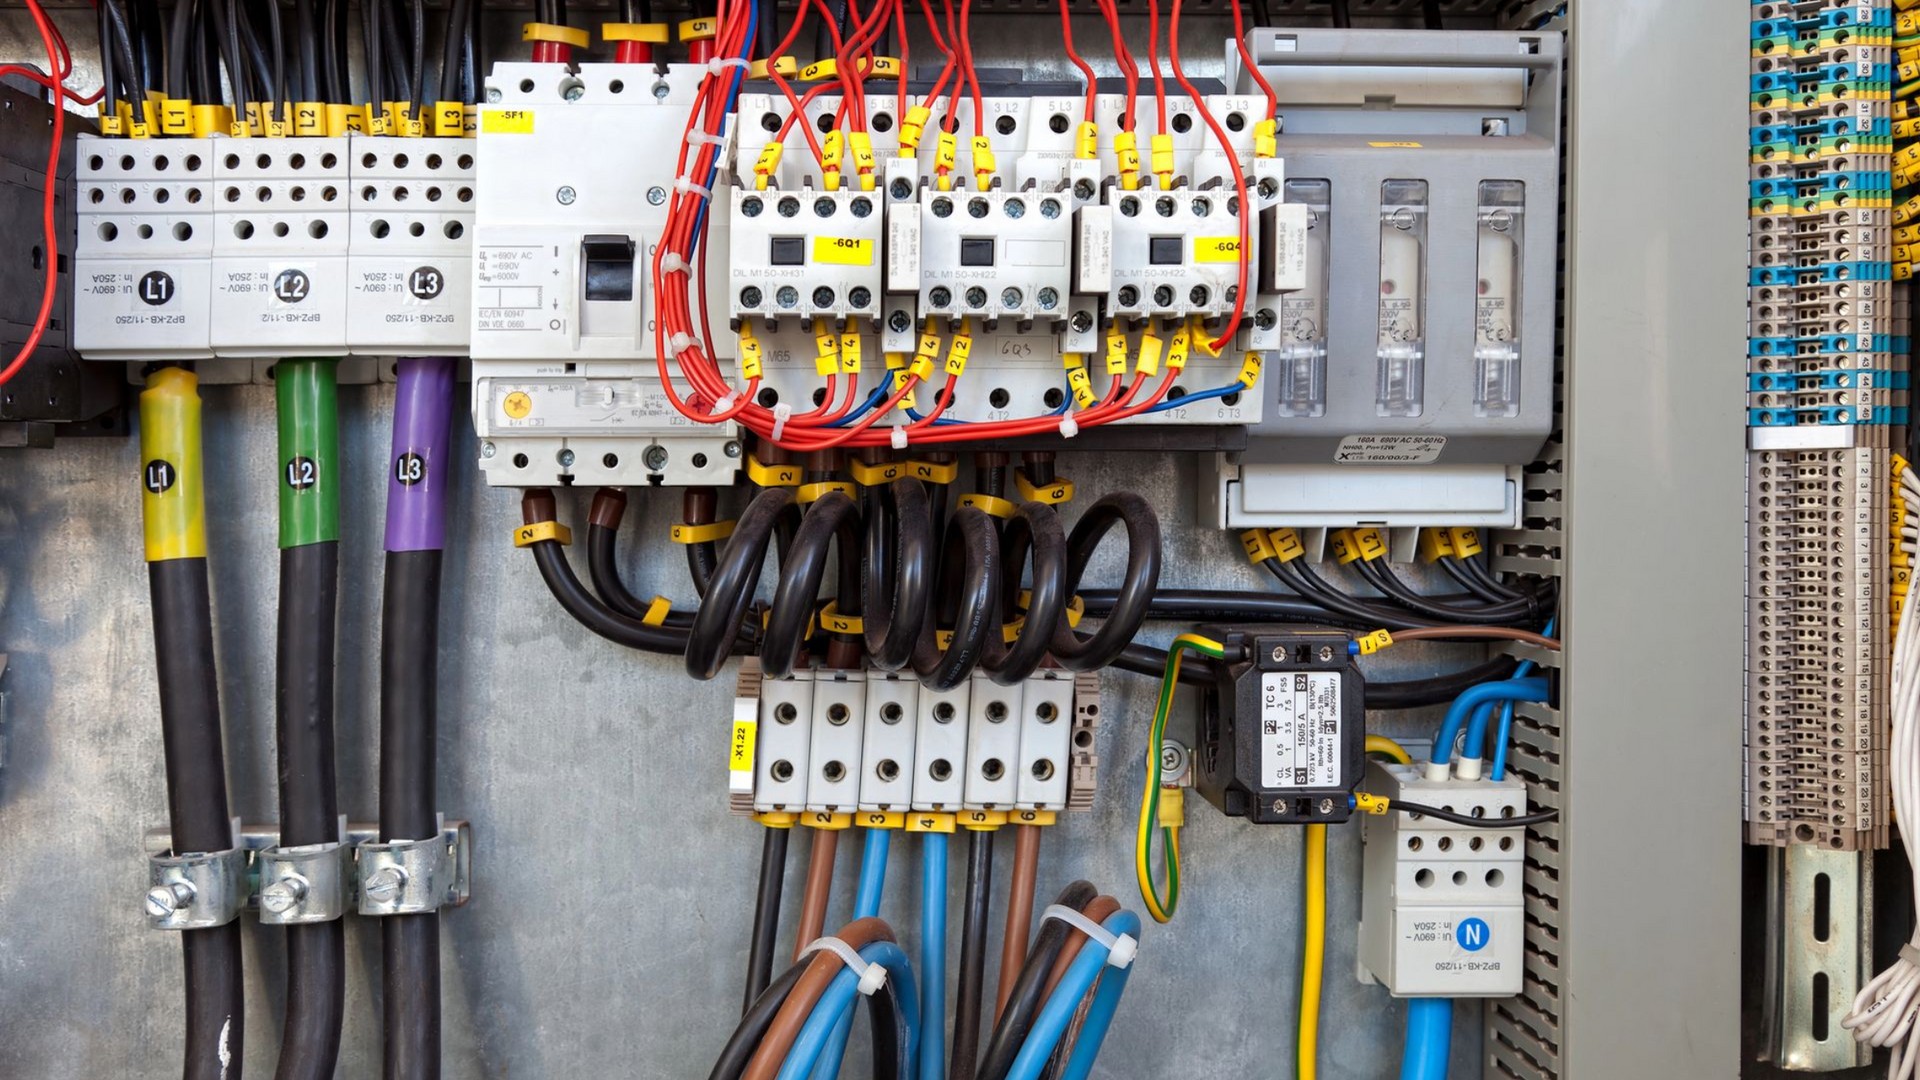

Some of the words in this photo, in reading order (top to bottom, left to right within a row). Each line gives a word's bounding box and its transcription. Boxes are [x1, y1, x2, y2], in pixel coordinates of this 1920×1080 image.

[1860, 9, 1868, 21] 28
[1860, 48, 1868, 59] 29
[875, 60, 890, 69] 5
[1860, 63, 1868, 74] 30
[805, 66, 818, 77] 3
[1903, 65, 1912, 76] 3
[816, 101, 822, 109] 3
[882, 99, 894, 109] L3
[995, 103, 1001, 112] 3
[1006, 103, 1018, 113] L2
[1049, 102, 1055, 111] 5
[1060, 102, 1072, 111] L3
[1171, 101, 1177, 111] 3
[1183, 101, 1194, 111] L2
[1226, 101, 1232, 110] 5
[1237, 101, 1249, 110] L3
[1860, 103, 1869, 113] 31
[168, 109, 186, 127] L1
[299, 109, 316, 128] L2
[443, 109, 460, 128] L3
[501, 111, 525, 119] -5F1
[108, 115, 119, 130] L1
[232, 122, 242, 132] L2
[346, 113, 361, 131] L2
[373, 118, 384, 133] L3
[1860, 119, 1869, 129] 32
[134, 124, 146, 137] L1
[271, 123, 283, 137] L2
[411, 121, 422, 135] L3
[1073, 161, 1082, 169] A1
[1861, 211, 1870, 222] 35
[1862, 231, 1870, 242] 36
[833, 239, 861, 248] -6Q1
[1862, 249, 1870, 260] 37
[92, 274, 116, 283] 250A
[227, 272, 252, 281] 250A
[363, 273, 388, 281] 250A
[146, 277, 166, 300] L1
[227, 284, 252, 293] 690V
[280, 276, 305, 298] L2
[362, 284, 386, 293] 690V
[413, 272, 438, 294] L3
[92, 285, 116, 294] 690V
[1862, 285, 1871, 296] 39
[1862, 303, 1871, 314] 40
[1862, 320, 1871, 330] 41
[887, 339, 897, 347] A2
[1862, 337, 1870, 348] 42
[767, 351, 791, 363] M65
[1862, 356, 1870, 367] 43
[1862, 375, 1870, 387] 44
[1862, 391, 1870, 403] 45
[987, 411, 993, 420] 4
[998, 410, 1010, 421] T2
[1165, 410, 1171, 419] 4
[1175, 410, 1187, 419] T2
[1217, 409, 1224, 418] 6
[1229, 409, 1241, 418] T3
[1862, 407, 1870, 418] 46
[289, 463, 314, 485] L2
[398, 458, 421, 480] L3
[918, 466, 931, 477] 2
[149, 464, 168, 489] L1
[780, 471, 792, 481] 2
[1892, 512, 1899, 522] 5
[521, 528, 534, 540] 2
[1464, 530, 1478, 549] L3
[1249, 537, 1261, 555] L1
[1278, 532, 1298, 553] L1
[1363, 532, 1383, 553] L2
[1333, 540, 1349, 558] L2
[1862, 586, 1870, 596] 10
[1860, 603, 1869, 612] 11
[832, 621, 848, 630] 2
[1861, 618, 1869, 628] 12
[1861, 633, 1869, 643] 13
[1861, 648, 1869, 658] 14
[1861, 663, 1869, 673] 15
[1280, 676, 1288, 693] FS5
[1296, 676, 1306, 691] S2
[1860, 679, 1868, 689] 16
[1266, 694, 1275, 710] TC
[1860, 694, 1868, 704] 17
[1860, 709, 1868, 719] 18
[1265, 720, 1276, 734] P2
[1309, 718, 1316, 727] Hz
[1325, 720, 1335, 734] P1
[1860, 724, 1868, 734] 19
[1298, 723, 1306, 747] 150/5
[735, 727, 746, 761] -X1.22
[1860, 738, 1868, 749] 20
[1276, 743, 1284, 756] 0.5
[1860, 757, 1868, 767] 21
[1276, 767, 1284, 779] CL
[1285, 766, 1292, 779] VA
[1296, 770, 1306, 783] S1
[1860, 772, 1869, 783] 22
[1861, 787, 1869, 798] 23
[1861, 802, 1869, 813] 24
[816, 812, 831, 823] 2
[870, 814, 885, 824] 3
[972, 812, 986, 822] 5
[1861, 817, 1870, 828] 25
[920, 818, 936, 829] 4
[1413, 921, 1437, 930] 250A
[1413, 932, 1436, 942] 690V
[1465, 924, 1481, 945] N
